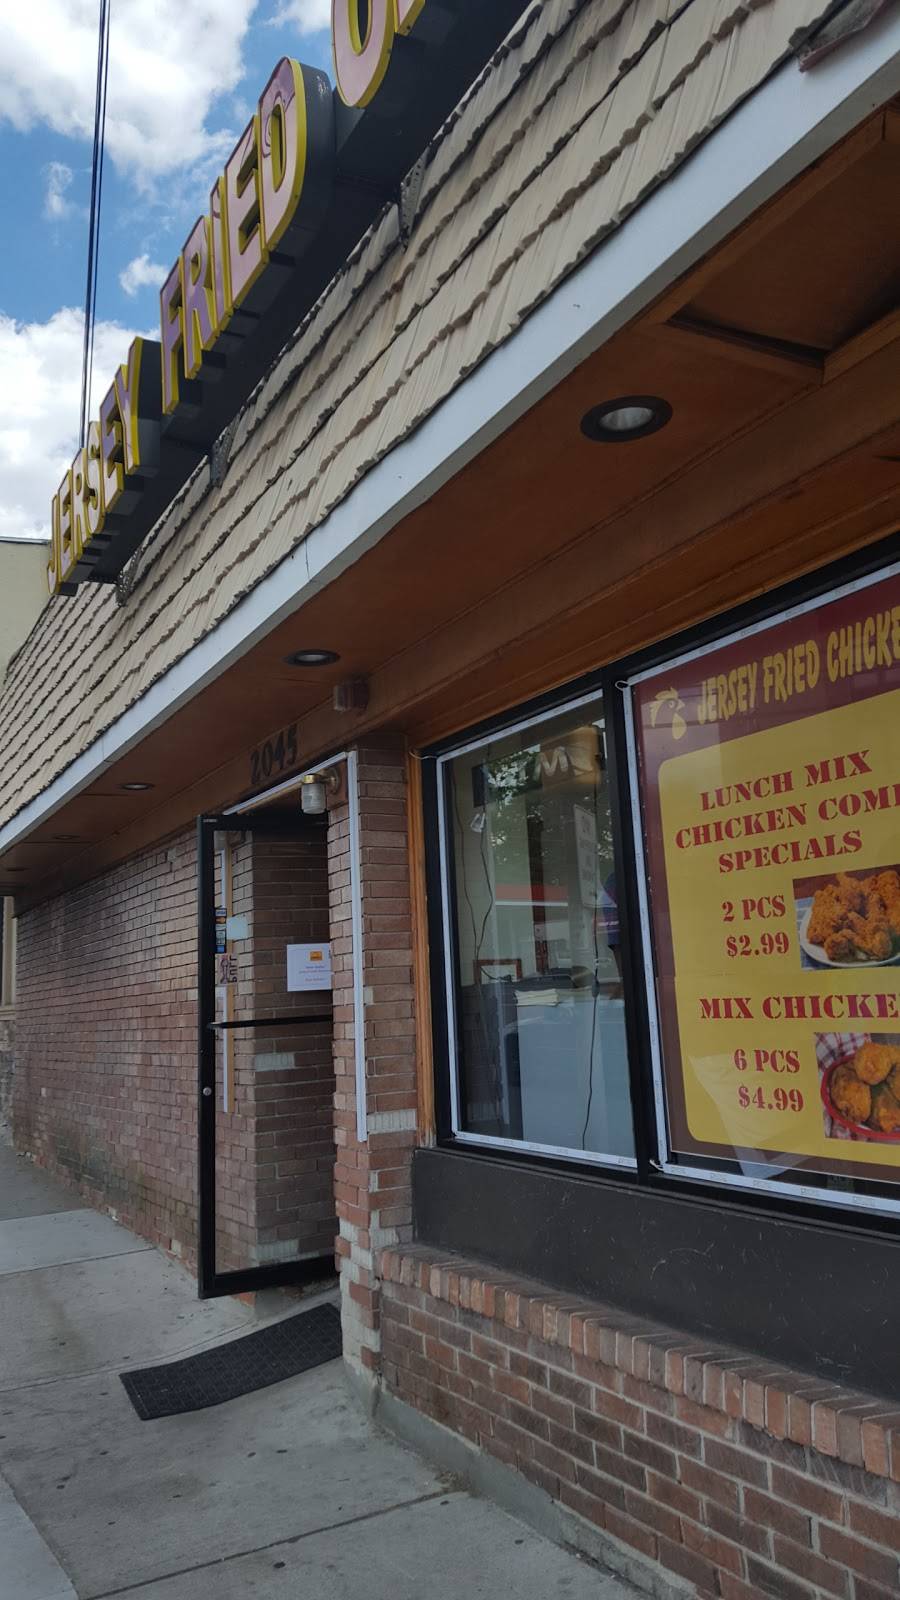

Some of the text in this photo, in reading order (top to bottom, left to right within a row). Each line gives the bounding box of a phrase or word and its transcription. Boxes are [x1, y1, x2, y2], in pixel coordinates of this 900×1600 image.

[47, 57, 306, 594] JERSEY FRIED
[697, 662, 757, 724] JERSEY
[763, 640, 820, 703] FRIED
[700, 750, 872, 811] LUNCH MIX
[675, 803, 807, 849] CHICKEN
[718, 830, 863, 873] SPECIALS
[722, 895, 786, 922] 2 PCS
[726, 932, 789, 957] $2.99
[700, 998, 752, 1019] MIX
[734, 1049, 800, 1073] 6 PCS
[738, 1083, 805, 1112] $4.99
